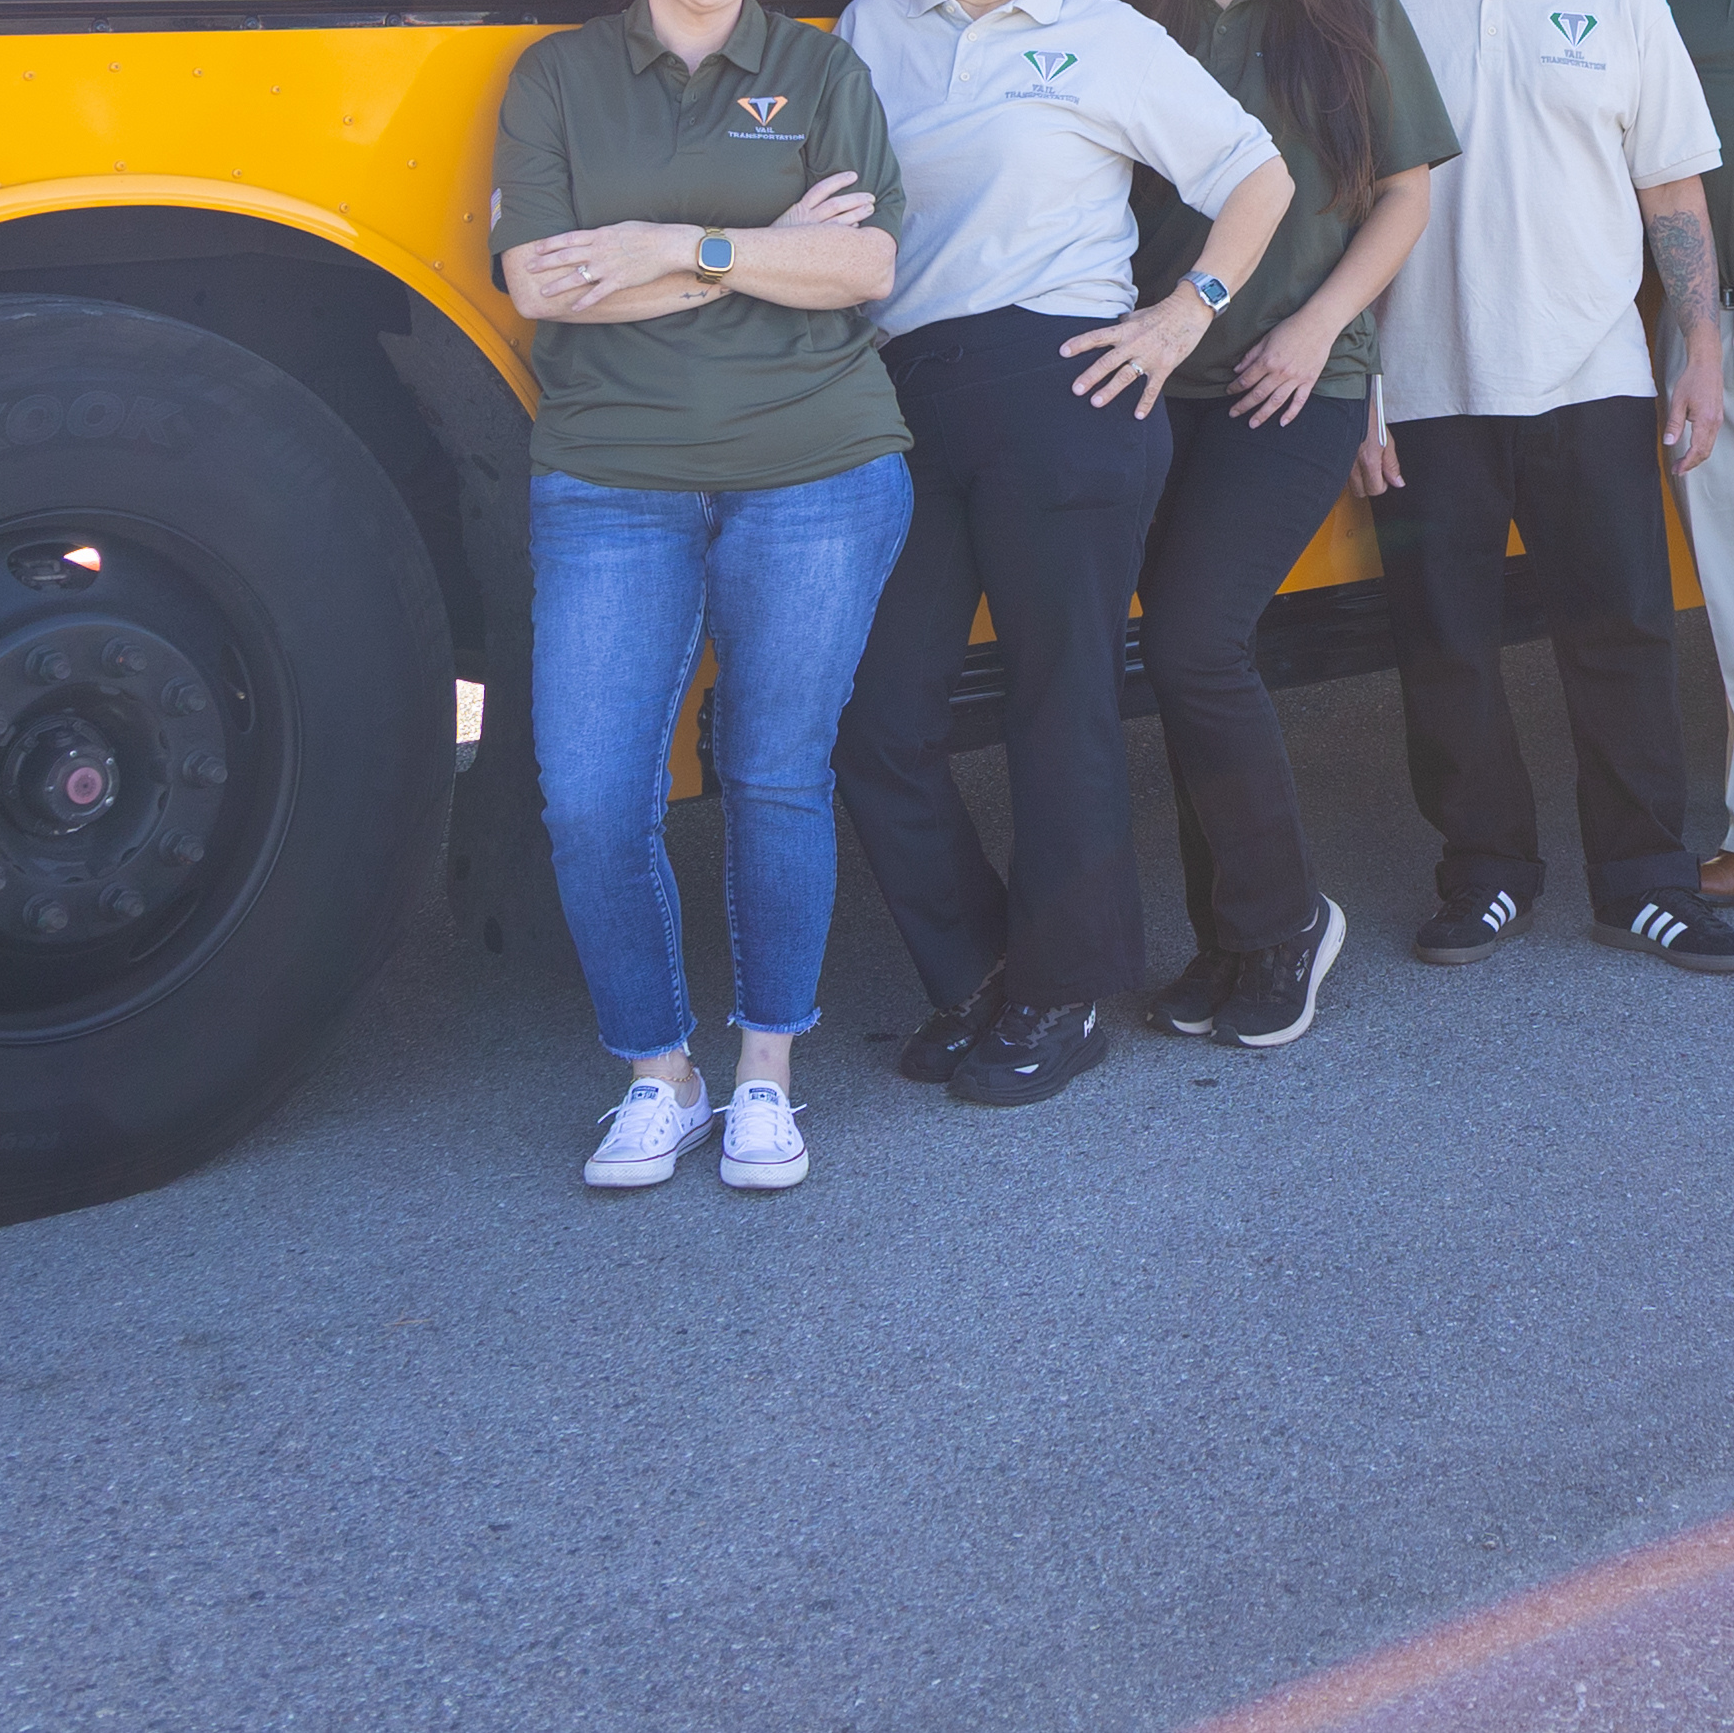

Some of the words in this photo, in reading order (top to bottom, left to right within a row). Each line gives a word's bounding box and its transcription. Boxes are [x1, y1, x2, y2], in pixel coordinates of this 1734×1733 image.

[1563, 48, 1585, 60] VAIL
[1540, 55, 1607, 71] TRANSPORTATION
[1031, 83, 1057, 95] VAIL
[1004, 91, 1081, 105] TRANSPORTATION
[727, 131, 806, 141] TRANSPORTATION
